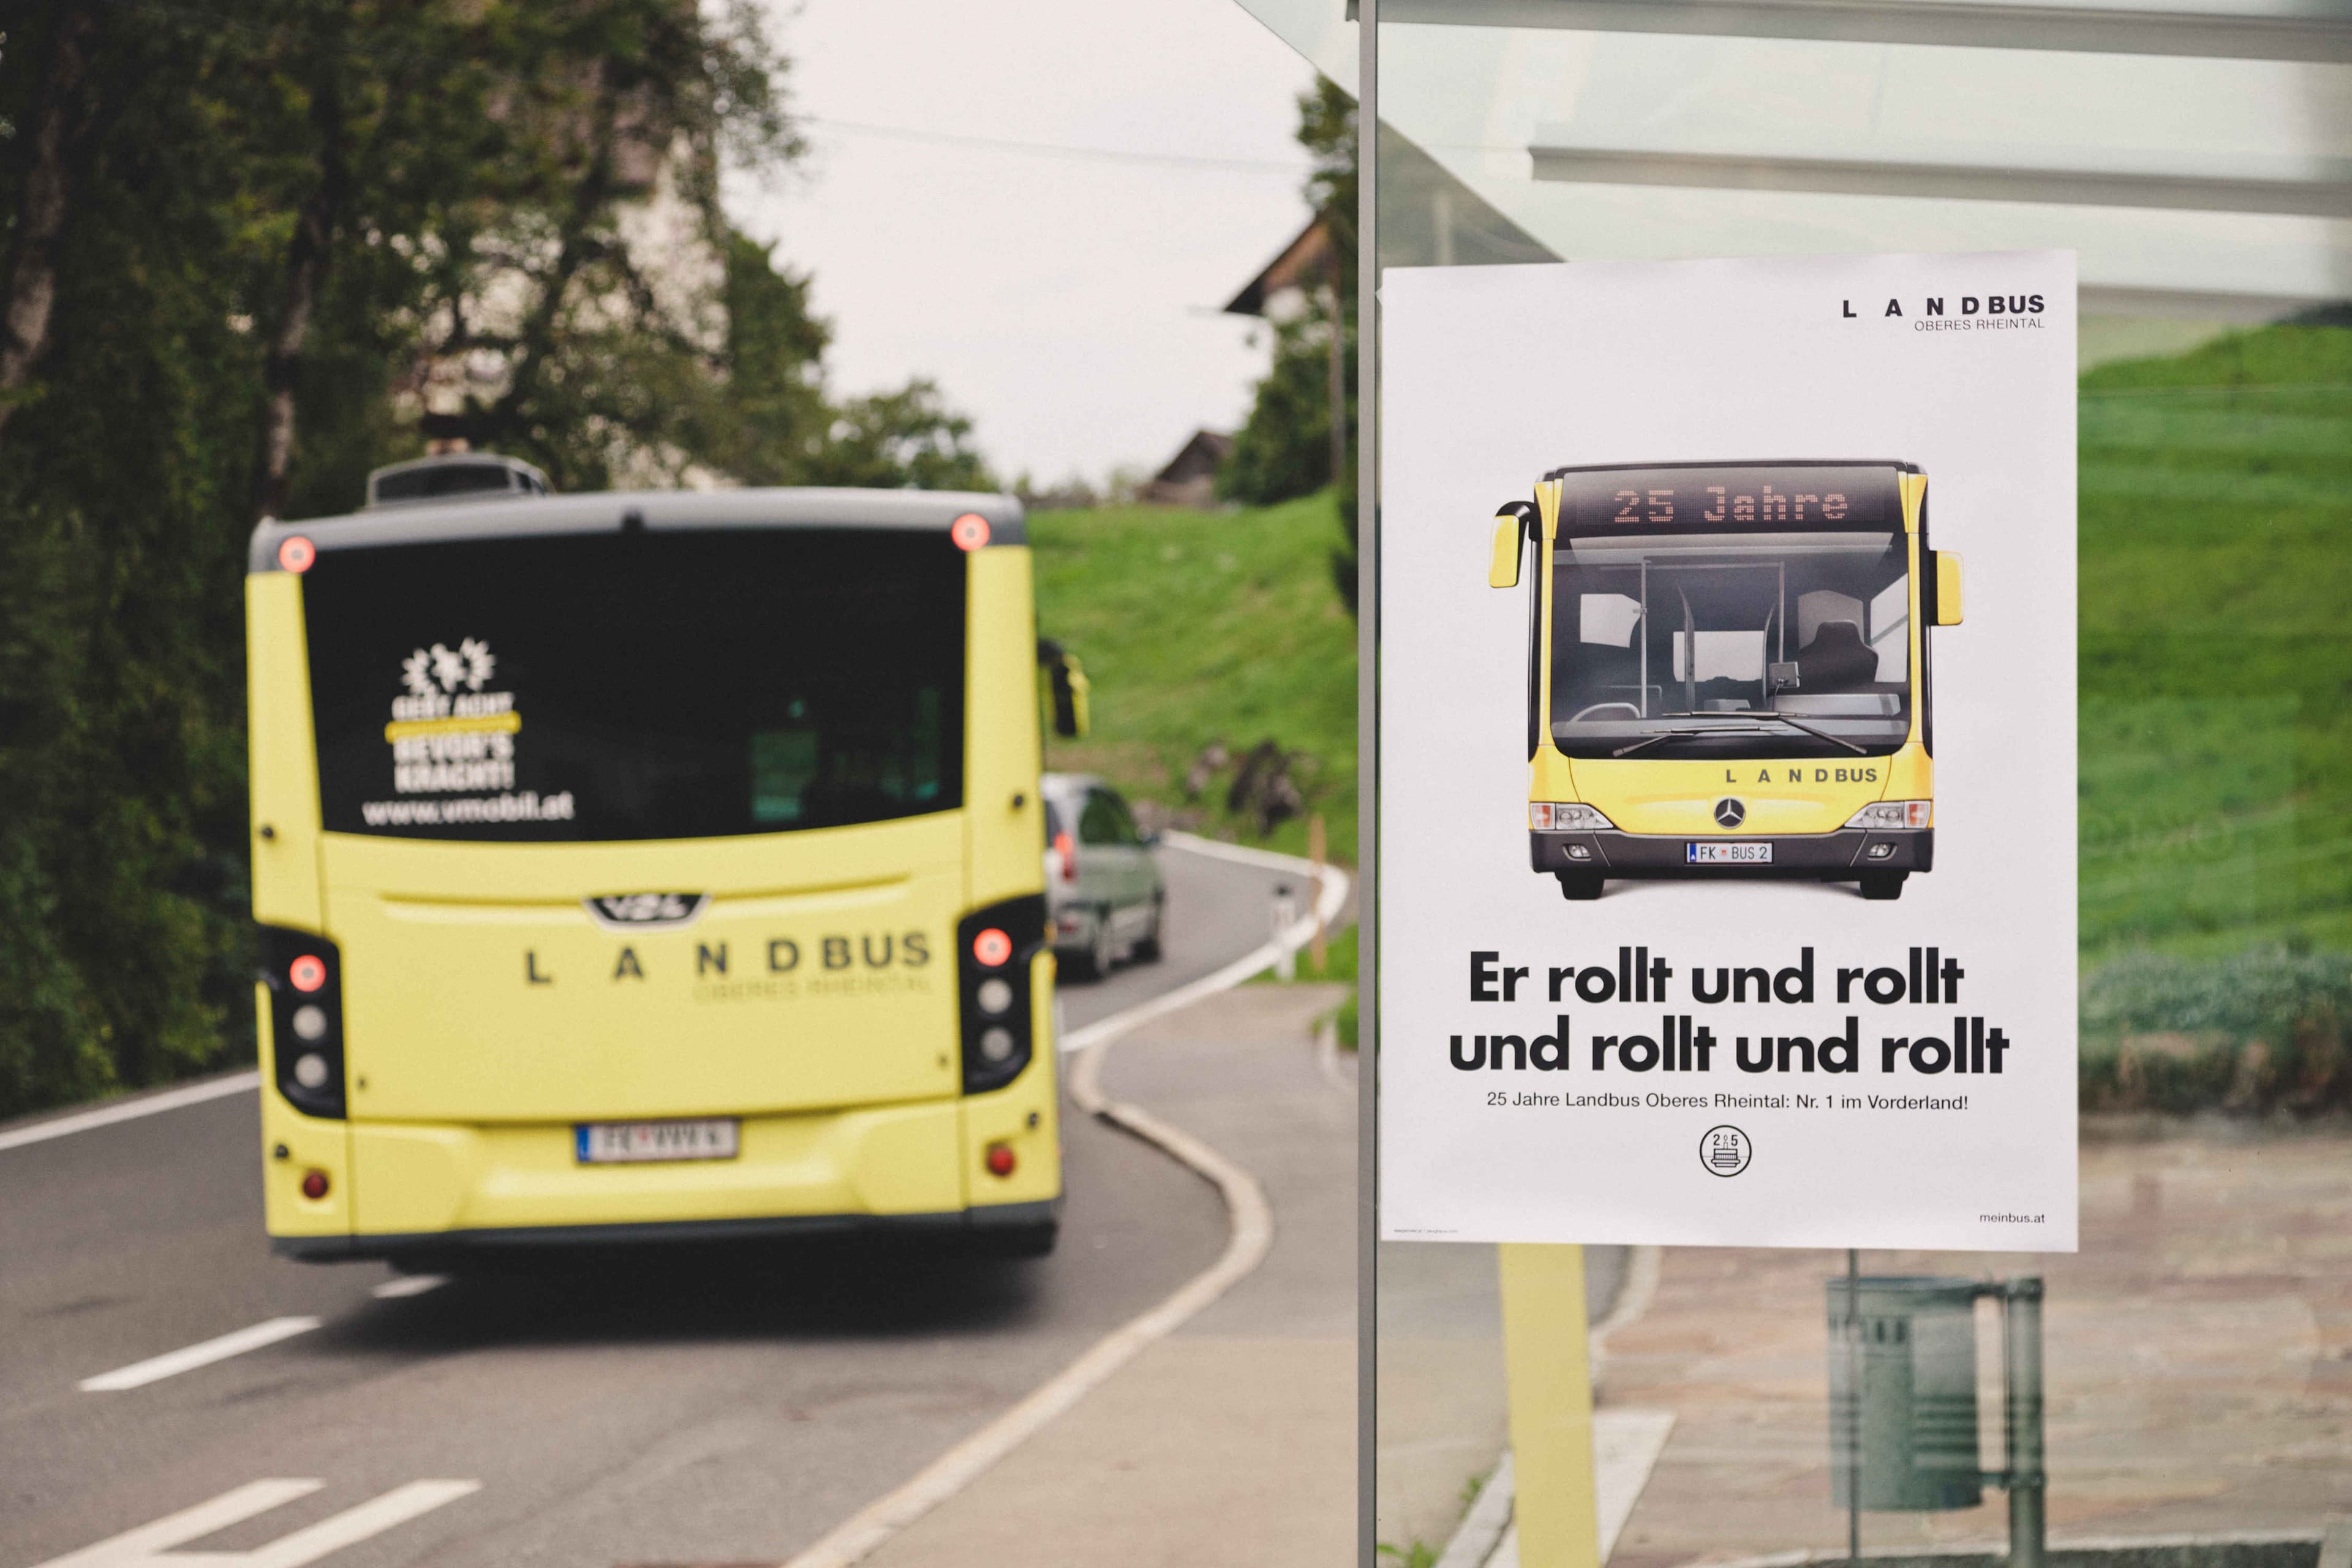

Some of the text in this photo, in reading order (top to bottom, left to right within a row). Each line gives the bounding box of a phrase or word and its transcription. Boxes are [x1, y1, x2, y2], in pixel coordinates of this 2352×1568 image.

[1843, 295, 2045, 317] LANDBUS
[1914, 318, 2045, 331] OBERES RHEINTAL
[1615, 485, 1848, 522] 25 Jahre
[1726, 768, 1877, 783] LANDBUS
[362, 790, 575, 826] www.vmobil.at
[1700, 846, 1767, 859] FK BUS 2
[526, 933, 930, 984] LANDBUS
[1470, 946, 1965, 1005] Er rollt und rollt
[1450, 1014, 2010, 1074] und rollt und rollt
[1487, 1091, 1968, 1110] 25 Jahre Landbus Oberes Rheintal: Nr. 1 im Vorderland!
[1980, 1213, 2045, 1223] meinbus.at
